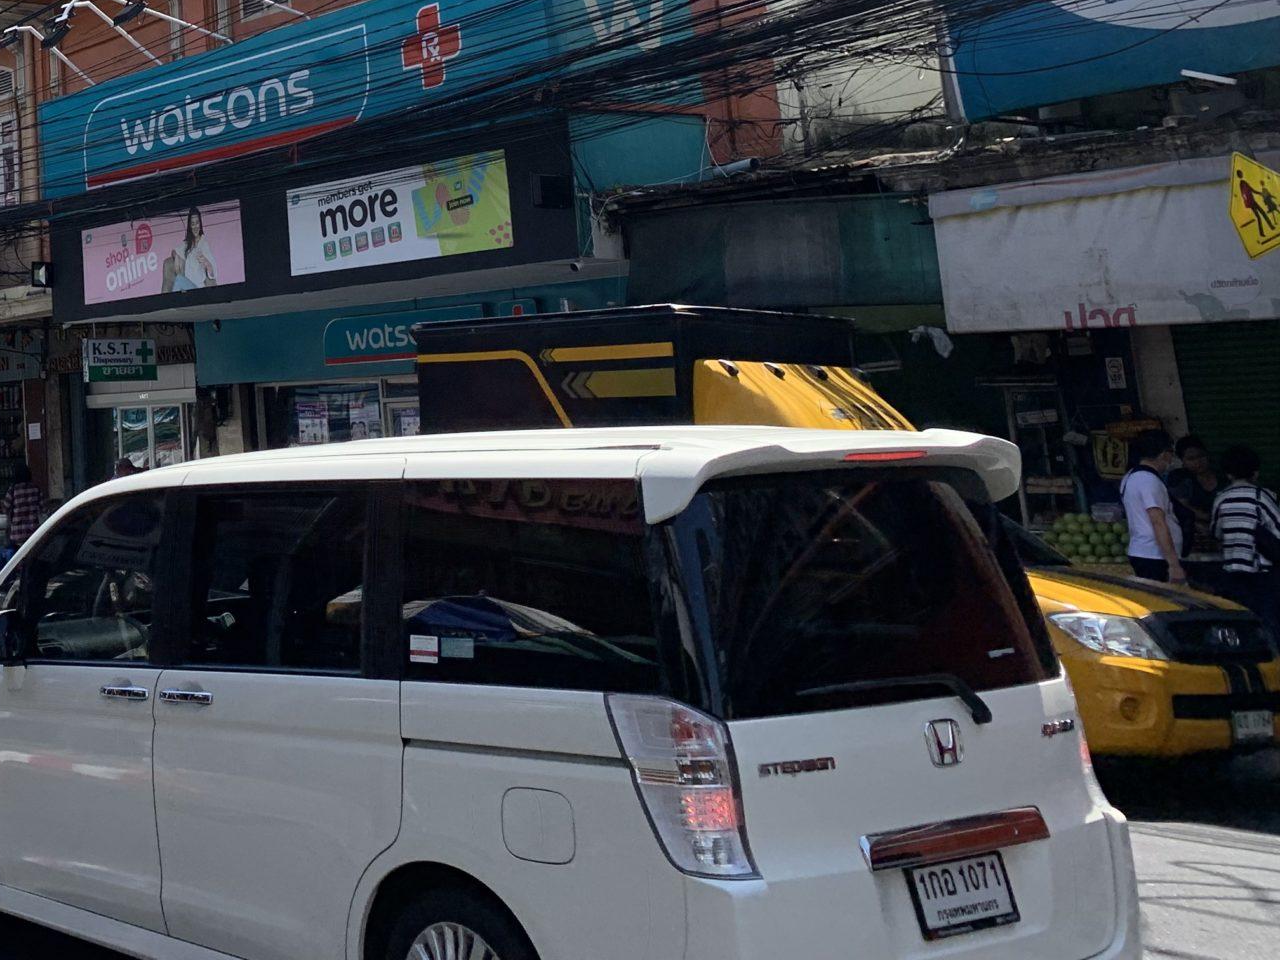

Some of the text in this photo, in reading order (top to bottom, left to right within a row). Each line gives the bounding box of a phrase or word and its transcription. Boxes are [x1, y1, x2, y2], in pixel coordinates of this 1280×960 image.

[120, 69, 314, 155] watsons
[318, 180, 373, 207] members get
[320, 188, 398, 238] more
[105, 247, 130, 268] shop
[106, 251, 158, 292] online
[92, 342, 133, 356] K.S.T.
[93, 356, 133, 365] Dispensary
[102, 365, 144, 376] ขายยา
[959, 861, 1001, 892] 1071
